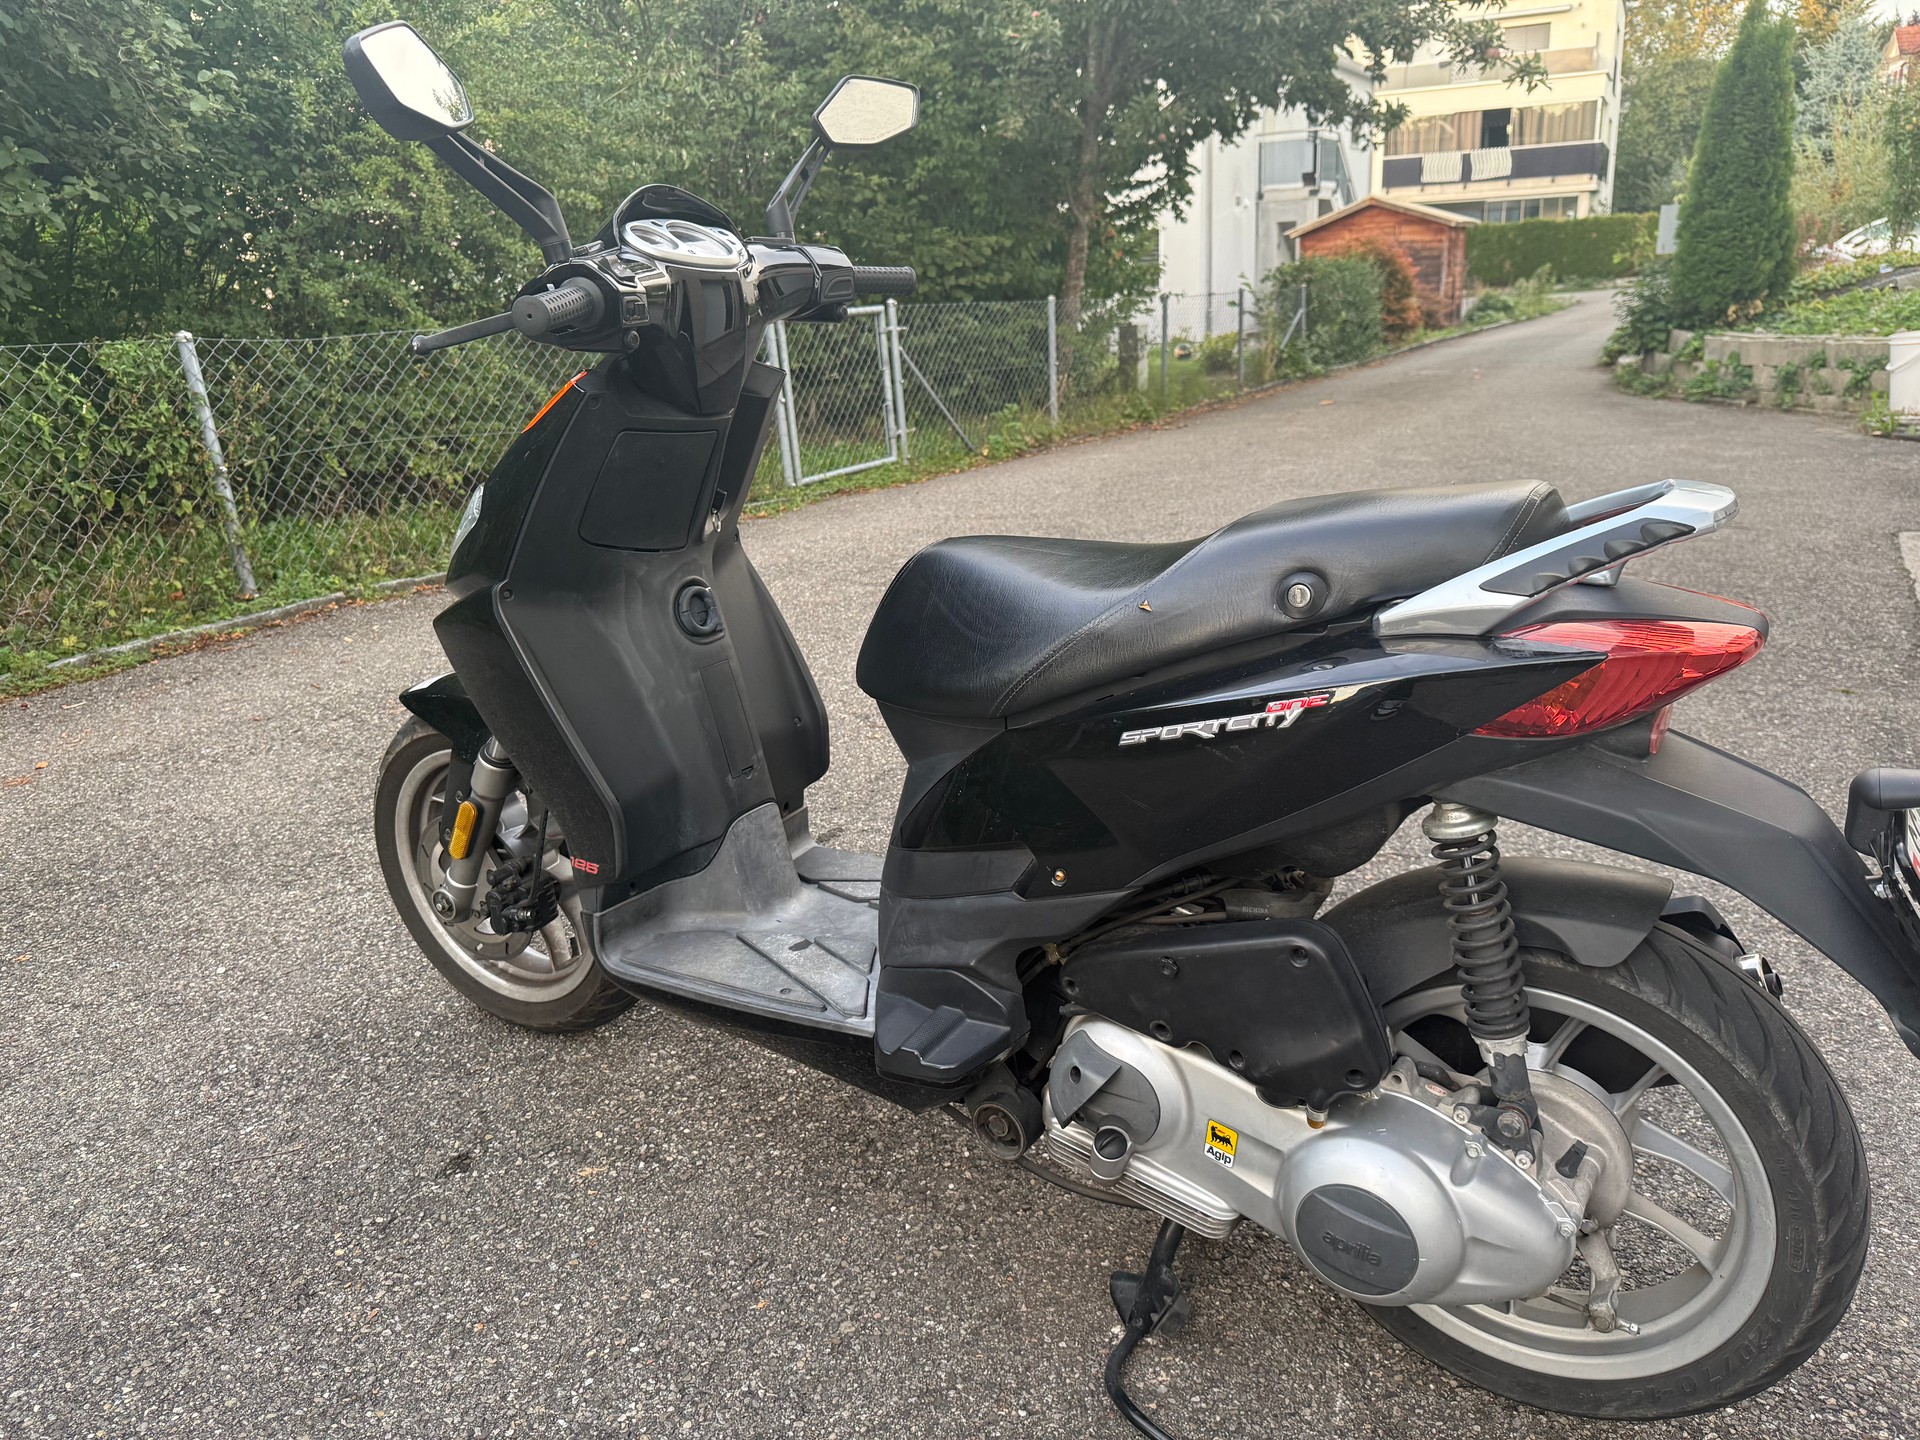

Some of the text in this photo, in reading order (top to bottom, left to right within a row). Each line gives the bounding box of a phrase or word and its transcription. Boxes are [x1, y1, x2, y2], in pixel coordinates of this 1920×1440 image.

[1118, 707, 1305, 746] SPORTCITY
[570, 856, 600, 875] 125
[1206, 1146, 1232, 1164] Agip
[1322, 1230, 1382, 1267] aprilia
